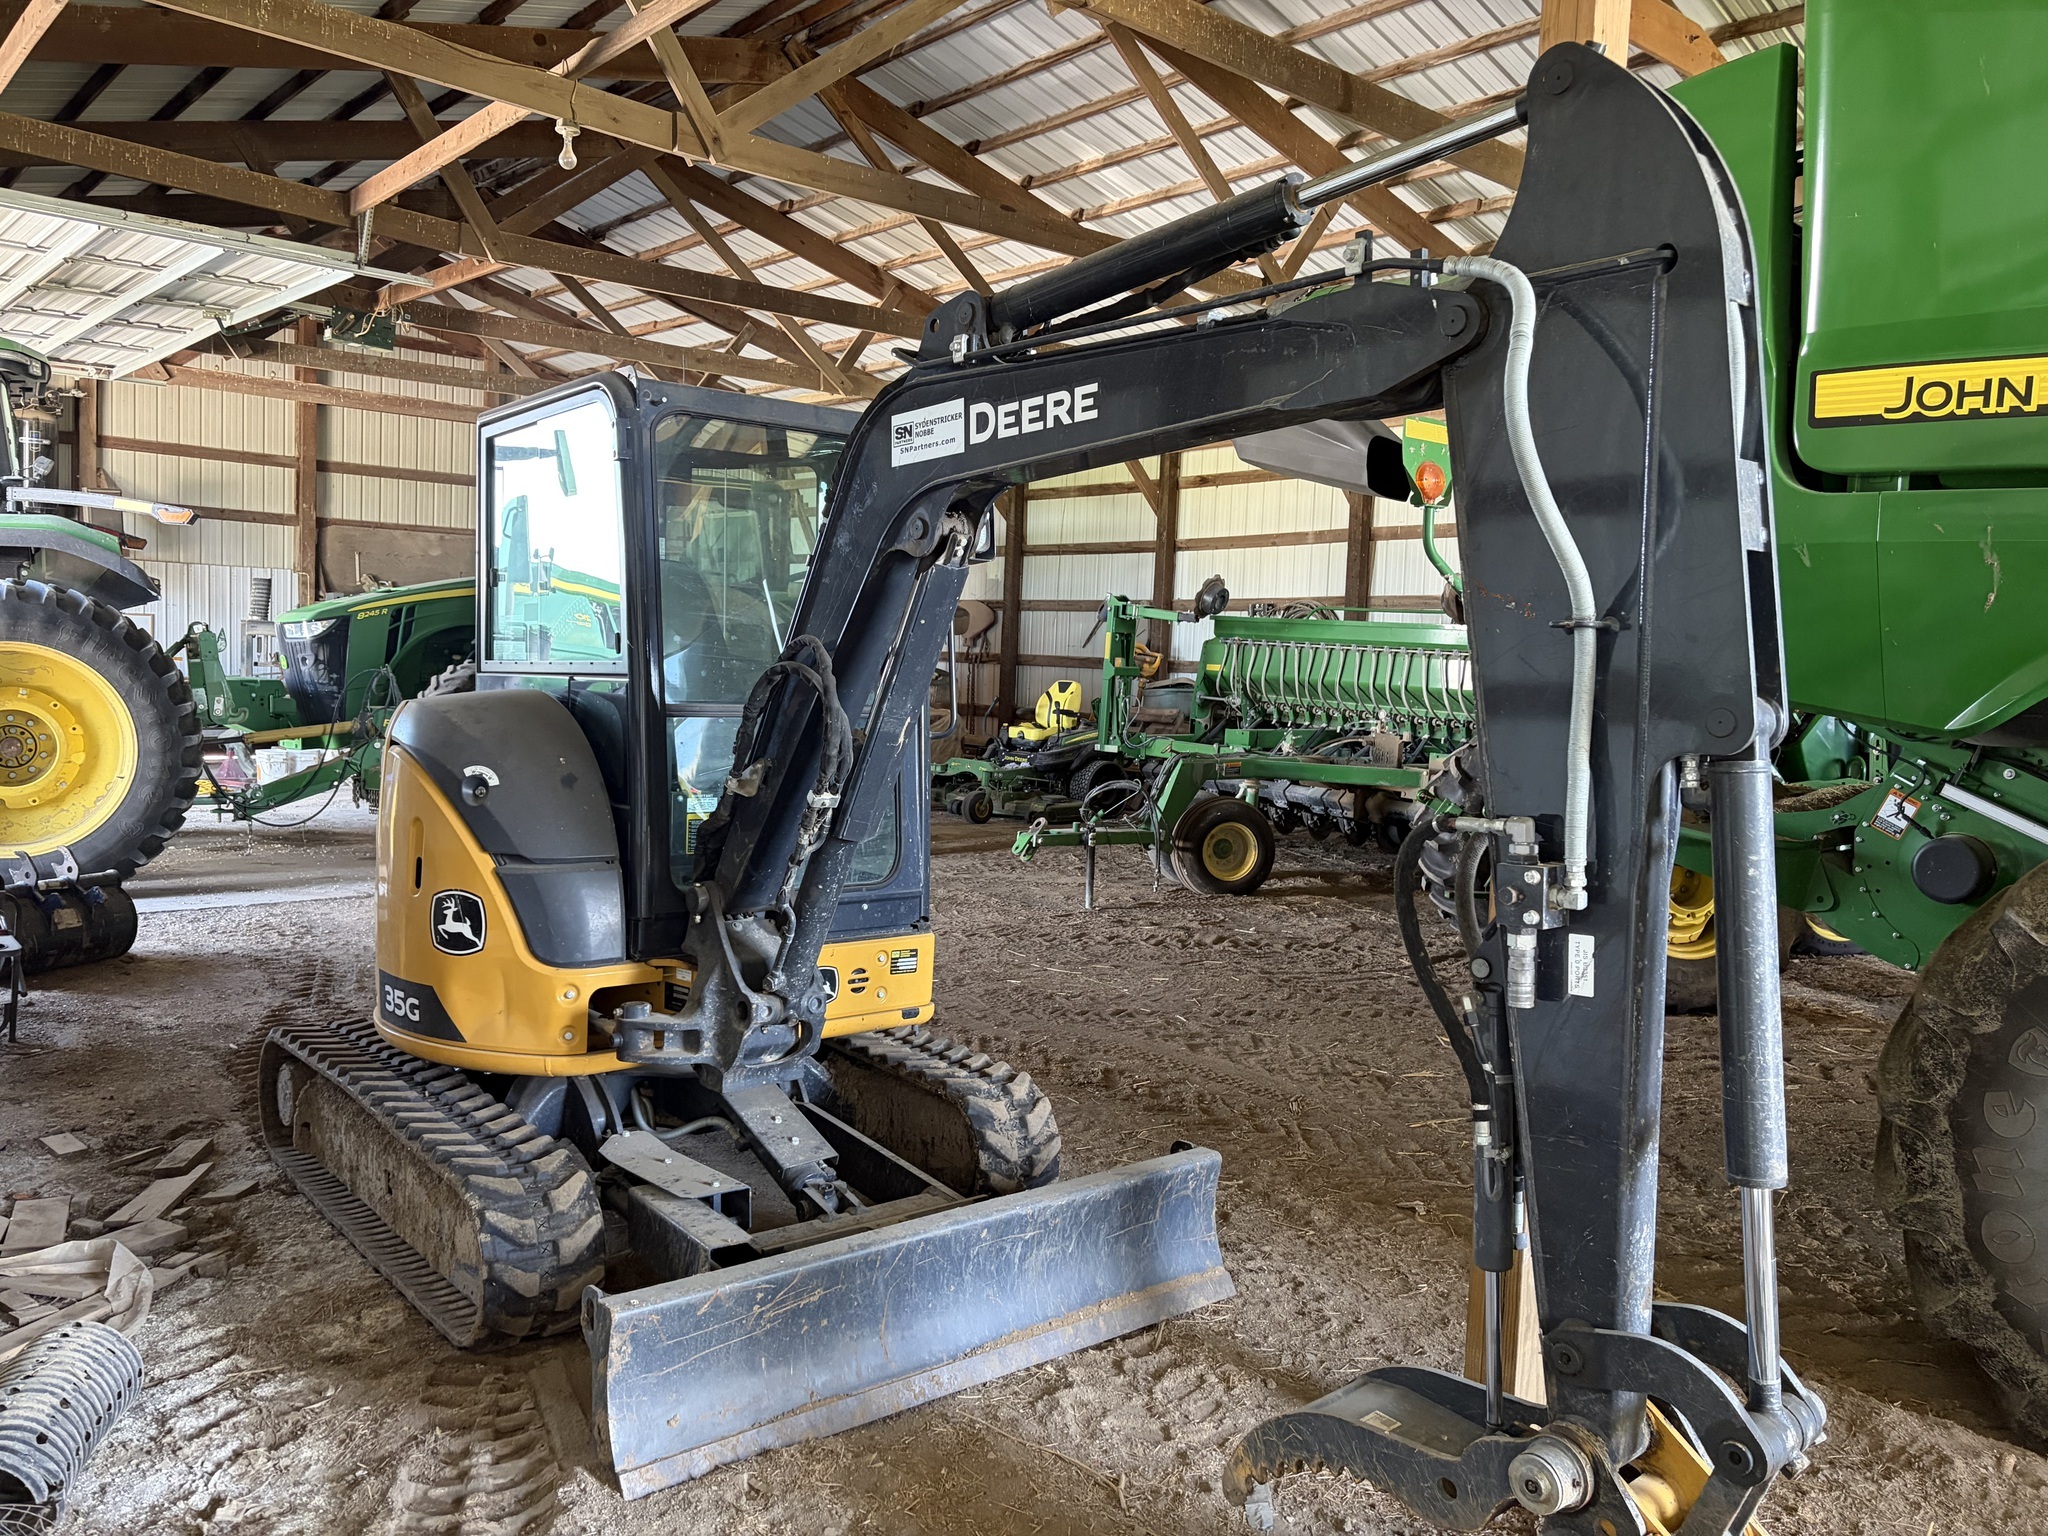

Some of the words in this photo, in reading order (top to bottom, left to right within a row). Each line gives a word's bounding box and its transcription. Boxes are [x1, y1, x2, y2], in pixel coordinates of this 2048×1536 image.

[1883, 375, 2035, 414] JOHN
[915, 412, 962, 430] SYDENSTRICKER
[969, 382, 1099, 445] DEERE
[895, 424, 913, 440] SN
[915, 427, 934, 438] NOBBE
[900, 437, 956, 454] SNPartners.com
[357, 609, 380, 620] 8245
[384, 984, 420, 1022] 35G
